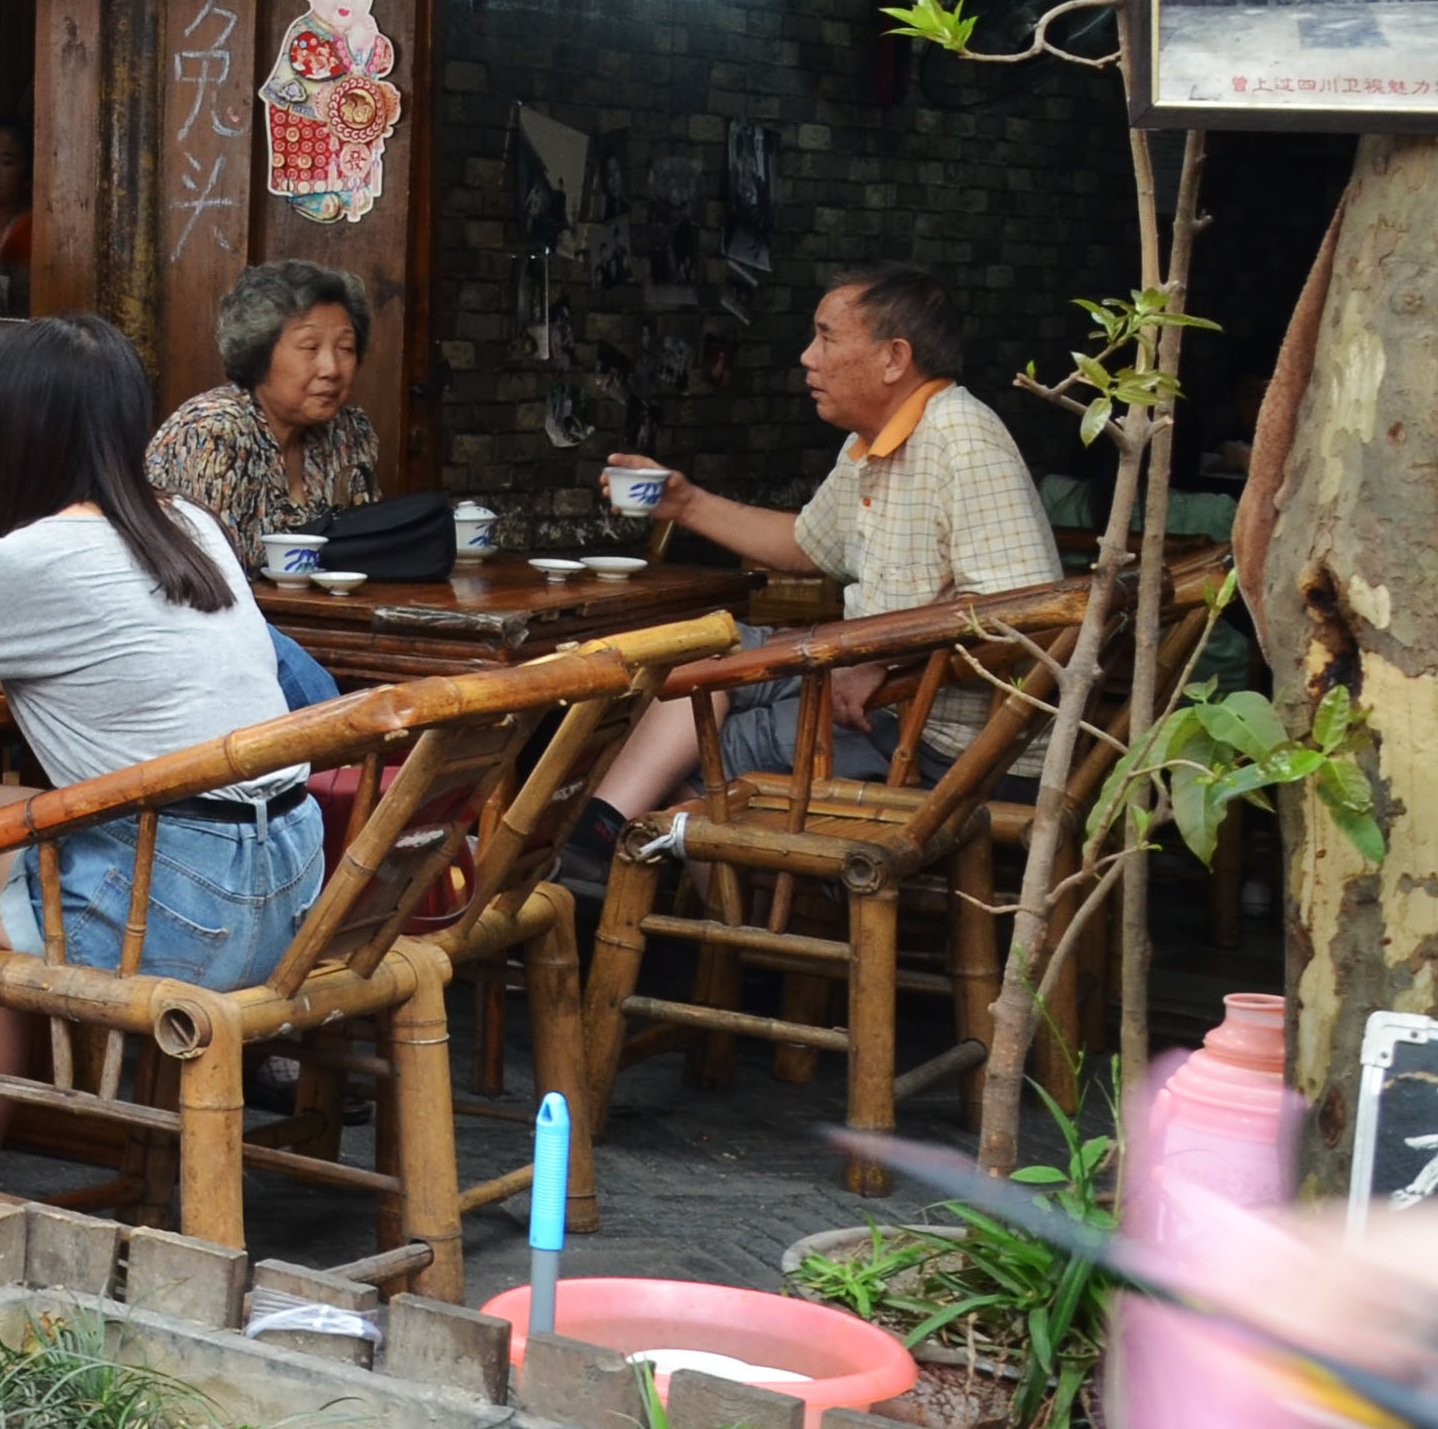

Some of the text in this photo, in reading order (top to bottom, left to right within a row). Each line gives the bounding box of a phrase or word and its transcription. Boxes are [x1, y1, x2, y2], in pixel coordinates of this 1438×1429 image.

[1231, 76, 1438, 97] 曾上过四川卫视魅力
